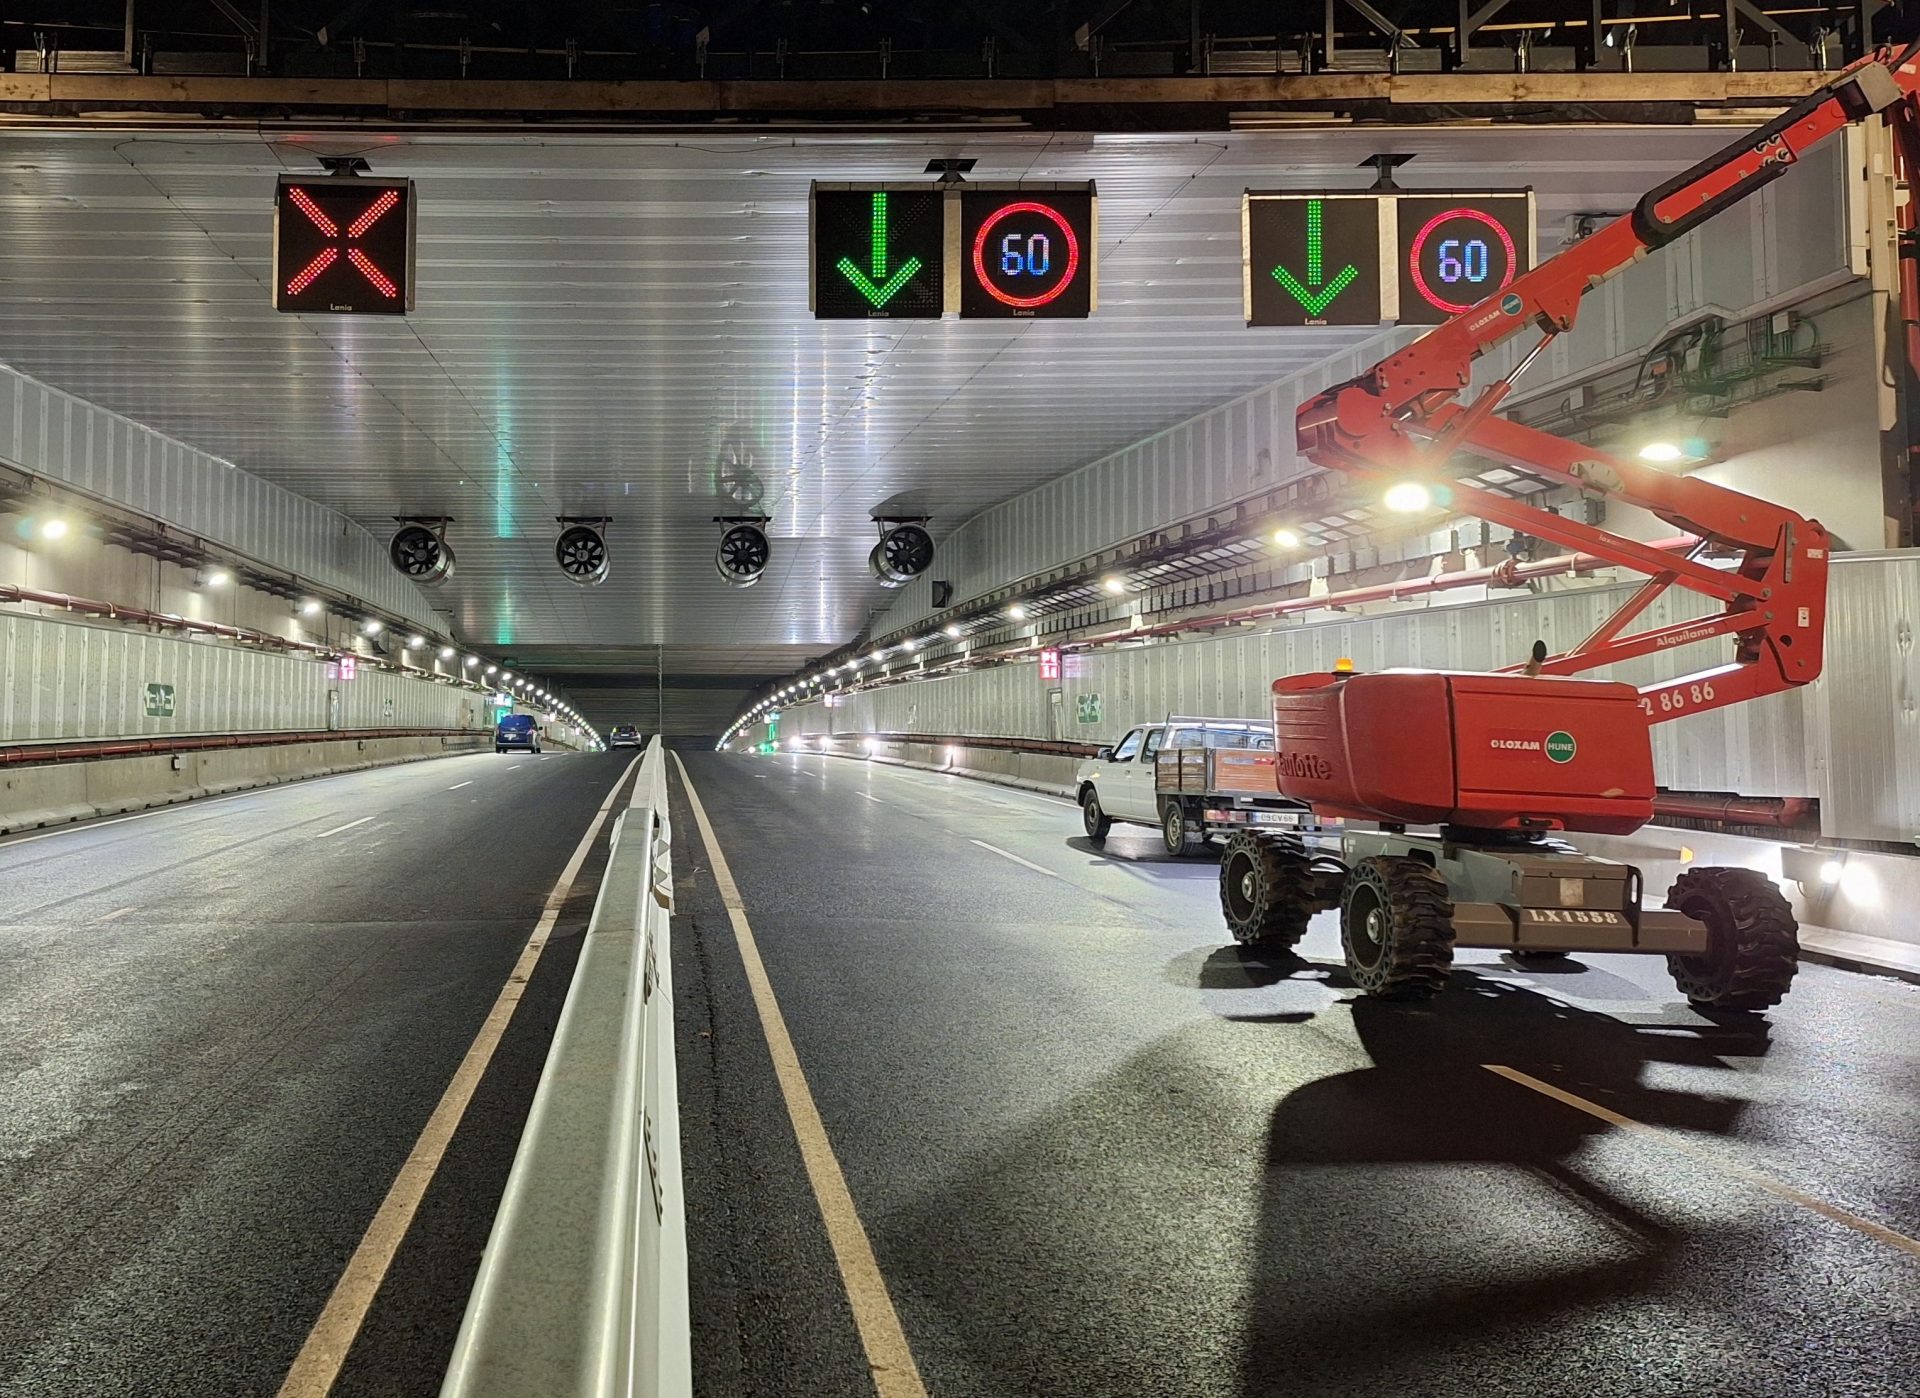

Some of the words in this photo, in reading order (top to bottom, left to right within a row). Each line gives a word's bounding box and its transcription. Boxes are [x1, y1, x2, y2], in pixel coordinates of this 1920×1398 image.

[1001, 233, 1050, 276] 60
[1438, 239, 1488, 283] 60
[1660, 689, 1684, 712] 86
[1690, 681, 1715, 704] 86
[1547, 742, 1574, 752] HUNE
[1276, 752, 1333, 780] aulotte
